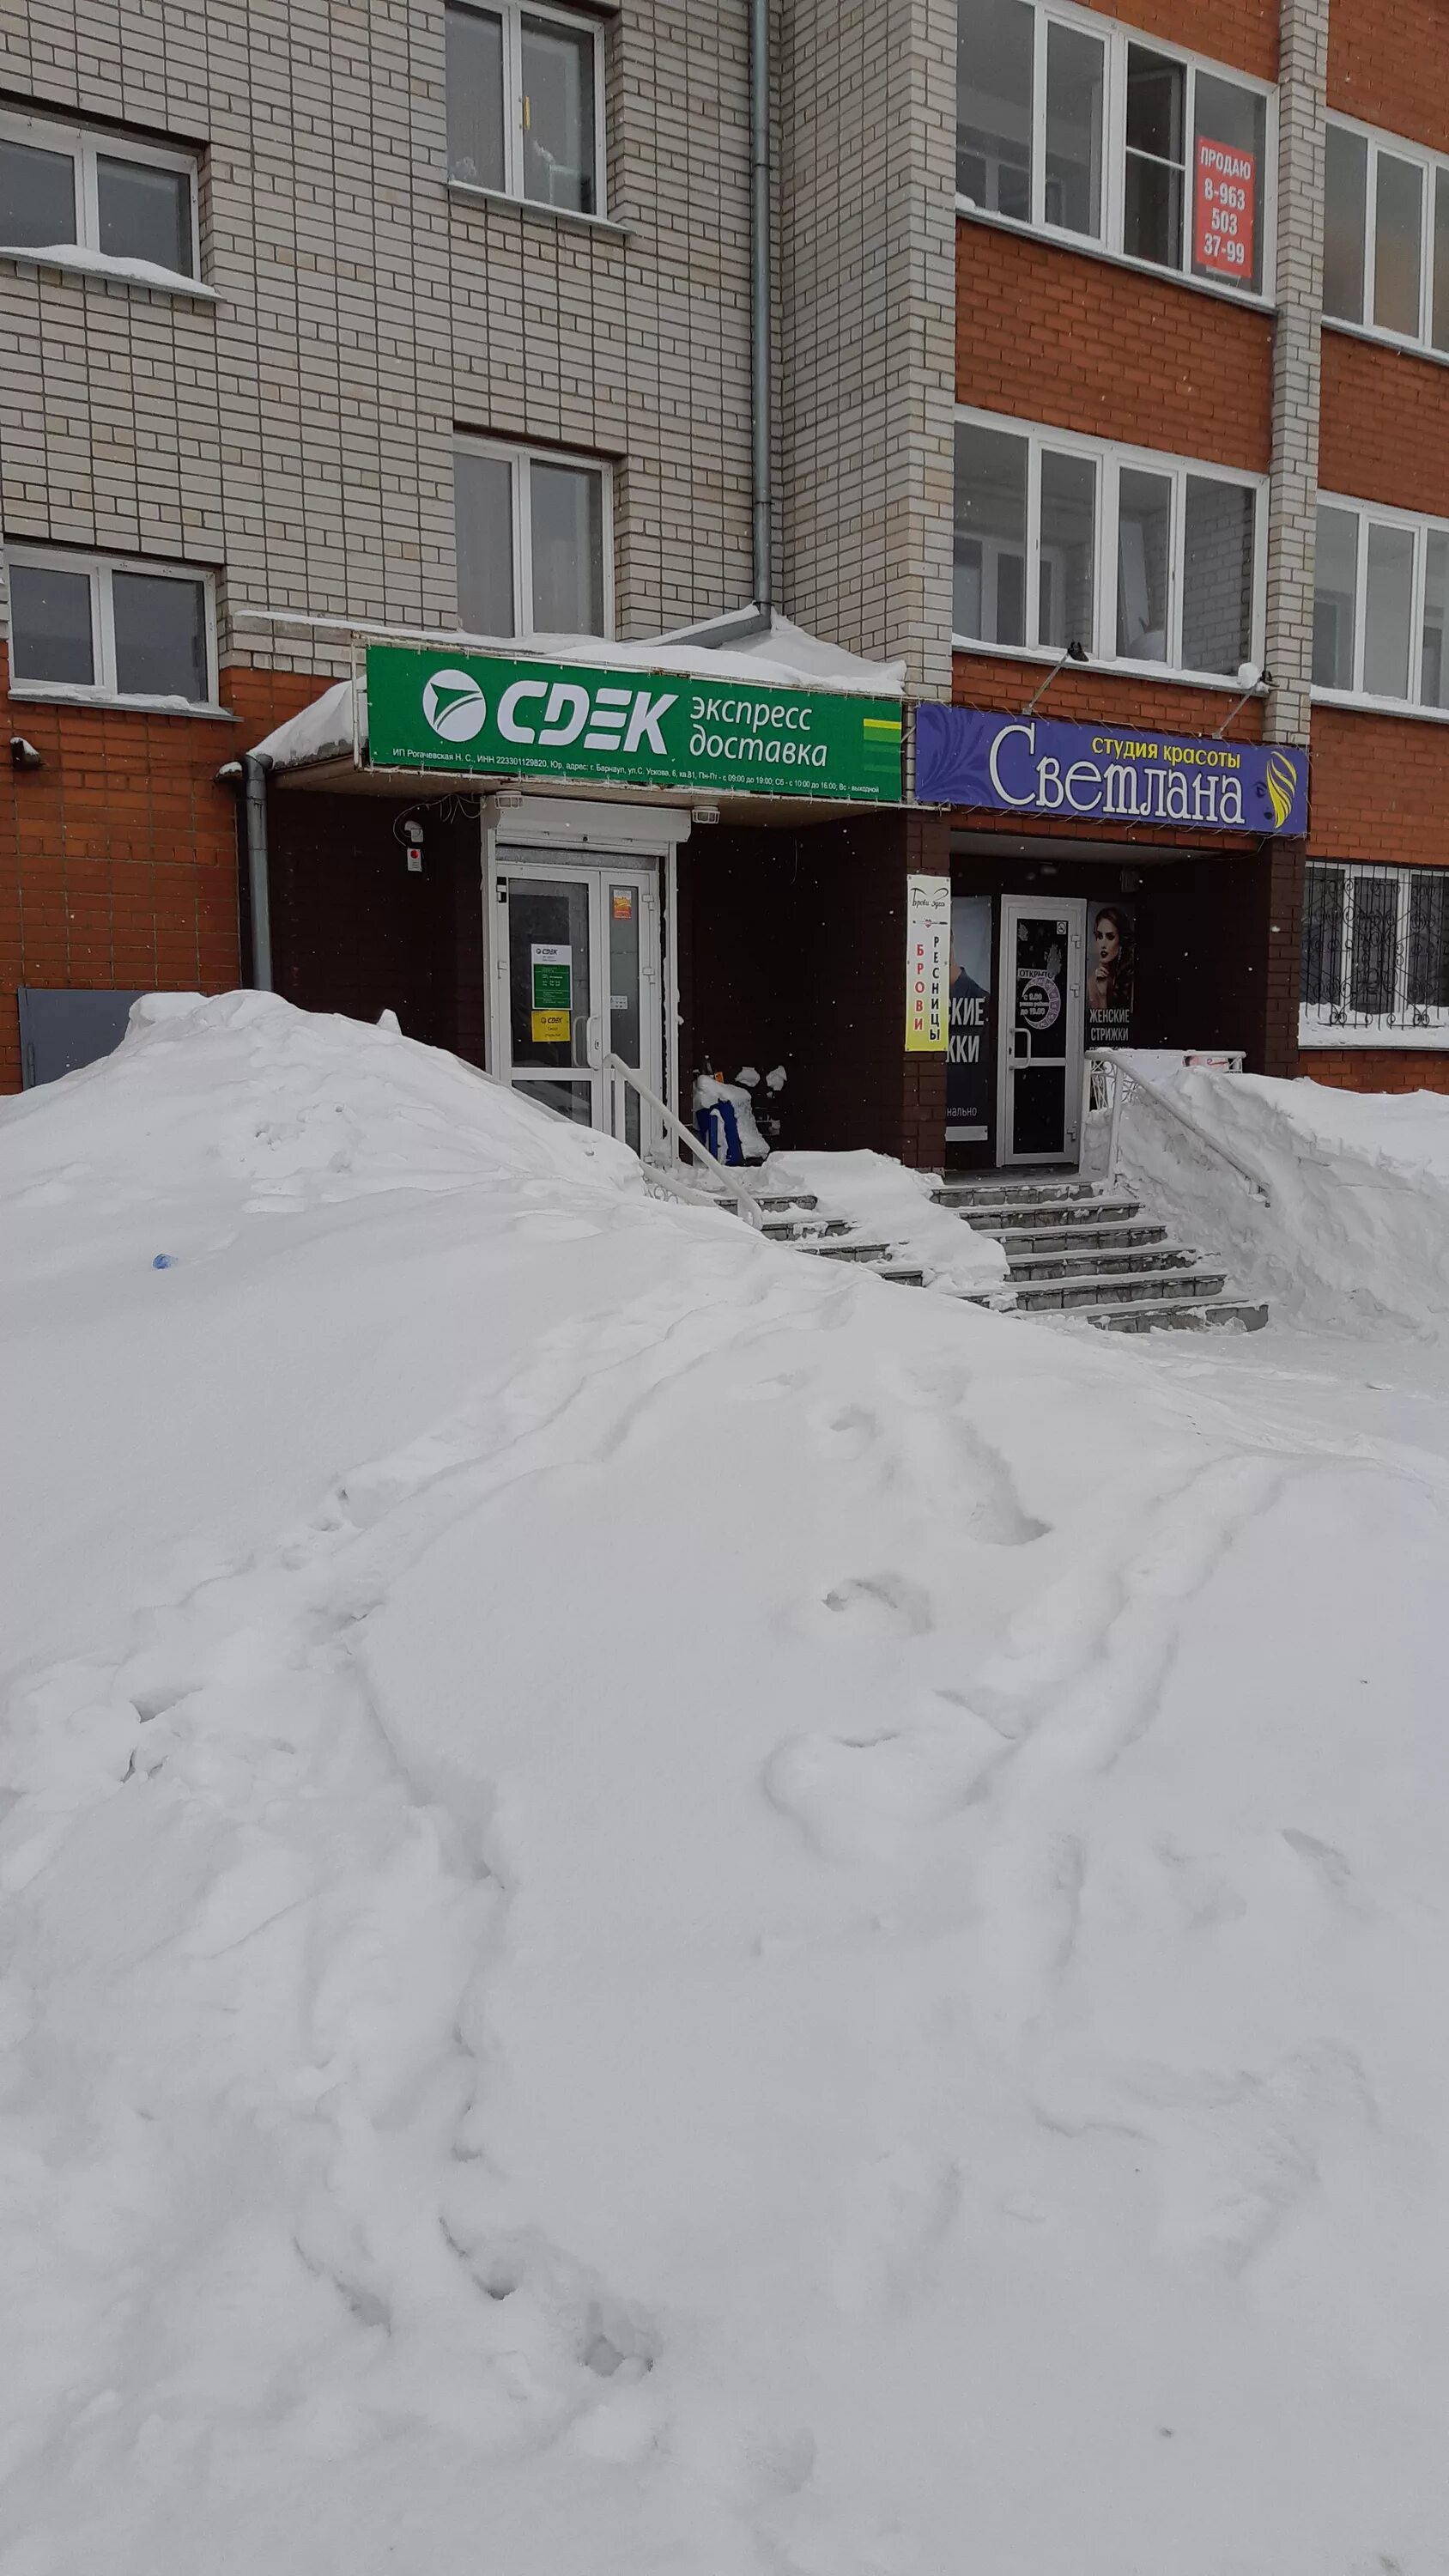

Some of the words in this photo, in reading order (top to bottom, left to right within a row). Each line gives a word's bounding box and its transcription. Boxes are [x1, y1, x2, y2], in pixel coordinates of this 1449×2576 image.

[1200, 146, 1251, 180] ПРОДАЮ
[1204, 178, 1245, 210] 8-963
[1211, 208, 1237, 235] 503
[1203, 234, 1245, 264] 37-99
[497, 679, 679, 755] CDEK
[690, 696, 812, 733] экспресс
[689, 723, 828, 767] доставка
[1092, 735, 1157, 760] студия
[1163, 745, 1241, 769] красоты
[392, 748, 405, 756] ИП
[407, 749, 453, 760] Рогачевская
[775, 777, 785, 786] Сб
[795, 780, 810, 788] 10:00
[989, 722, 1246, 824] Светлана
[914, 944, 925, 1030] БРОВИ
[929, 936, 941, 1041] РЕСНИЦЫ
[1088, 1008, 1130, 1024] ЖЕНСКИЕ
[1090, 1027, 1129, 1042] СТРИЖКИ
